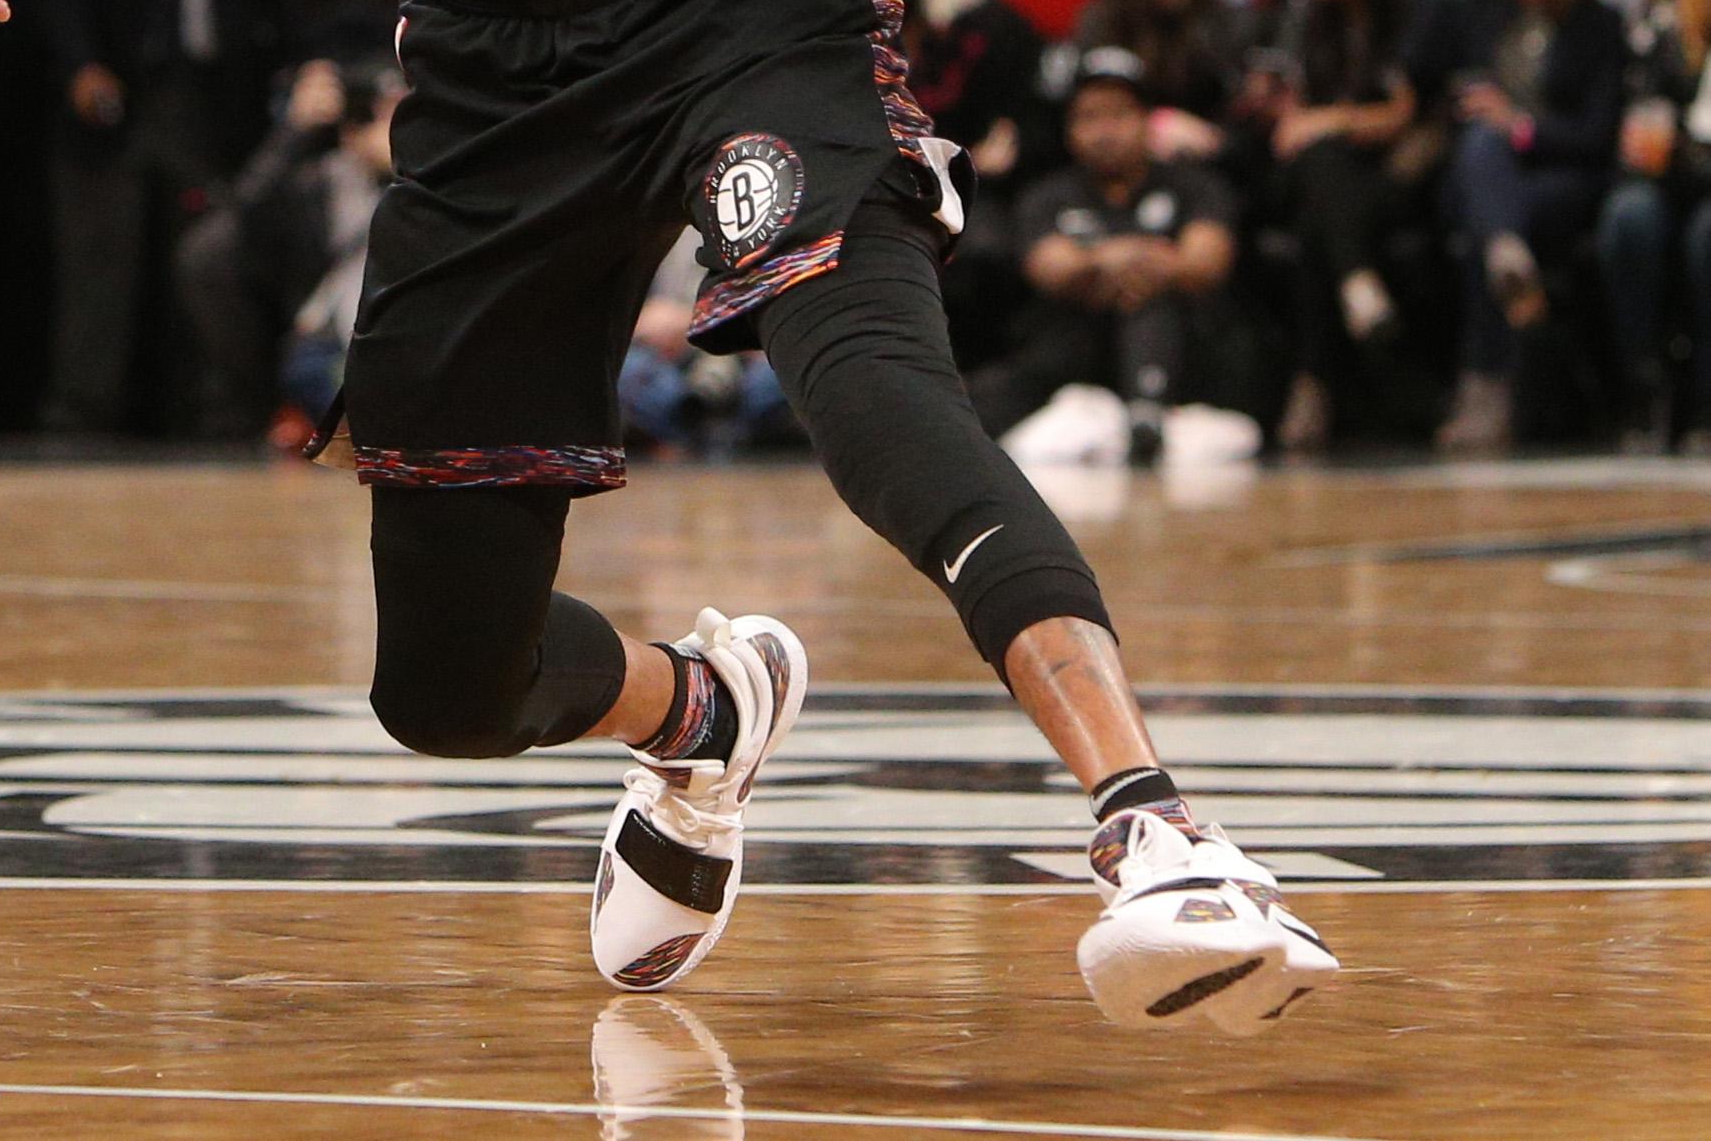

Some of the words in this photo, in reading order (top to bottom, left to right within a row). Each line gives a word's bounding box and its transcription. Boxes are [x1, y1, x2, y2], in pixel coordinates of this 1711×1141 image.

[709, 145, 788, 204] BROOKLYN
[732, 171, 756, 232] B
[747, 206, 788, 250] YORK
